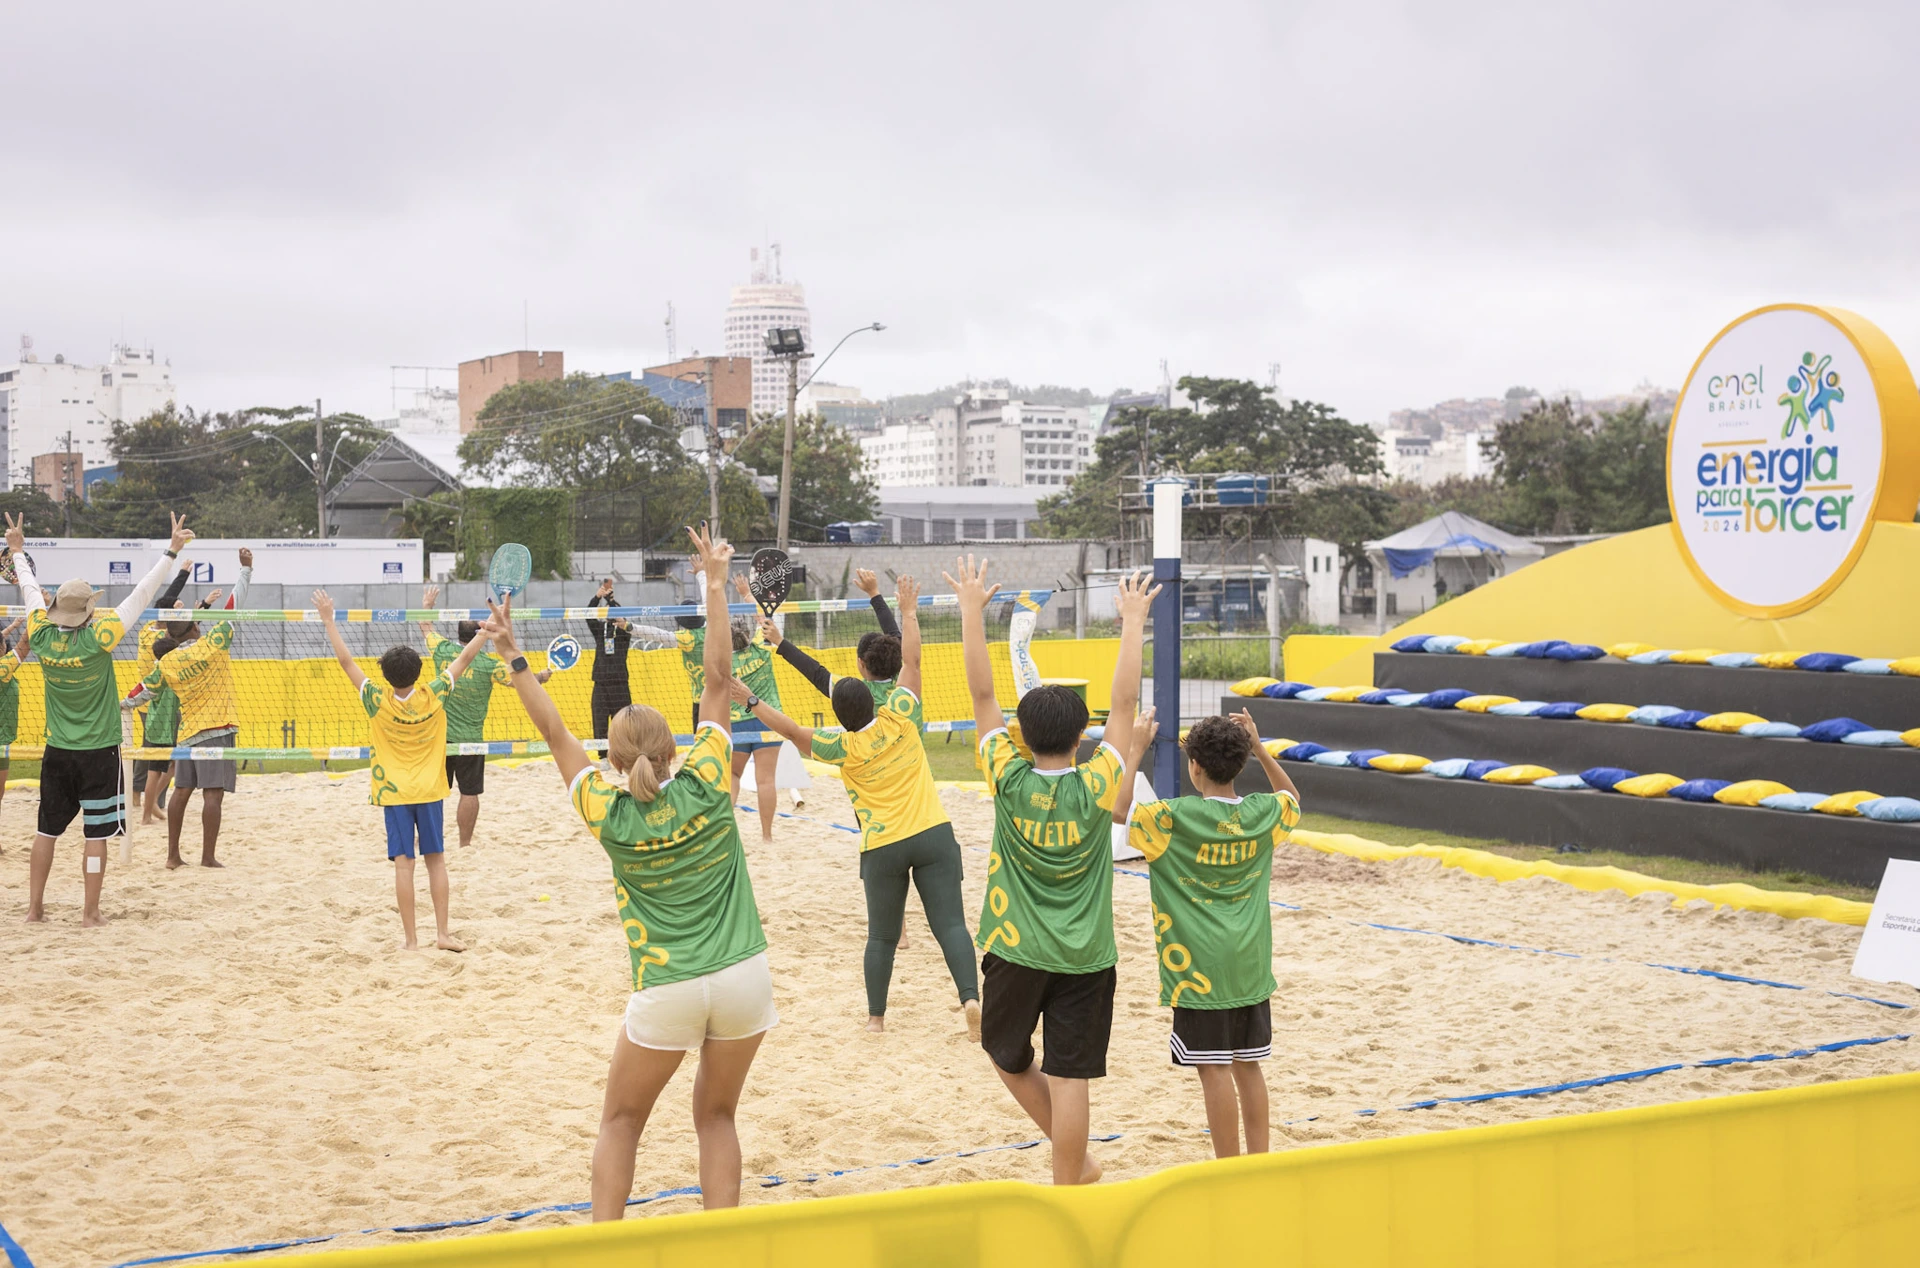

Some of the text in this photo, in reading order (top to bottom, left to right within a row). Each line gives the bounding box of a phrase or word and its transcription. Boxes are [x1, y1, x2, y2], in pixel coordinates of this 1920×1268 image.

[1708, 364, 1764, 398] enel
[1709, 398, 1762, 413] BRASIL
[1697, 434, 1838, 495] energia
[1697, 488, 1742, 514] para
[1743, 488, 1854, 533] torcer
[1703, 520, 1740, 533] 2026
[178, 659, 209, 681] ATLETA
[634, 814, 710, 852] ATLETA
[1012, 816, 1082, 847] ATLETA
[1195, 839, 1258, 867] ATLETA
[1882, 920, 1907, 931] Esporte
[1885, 913, 1916, 924] Secretaria
